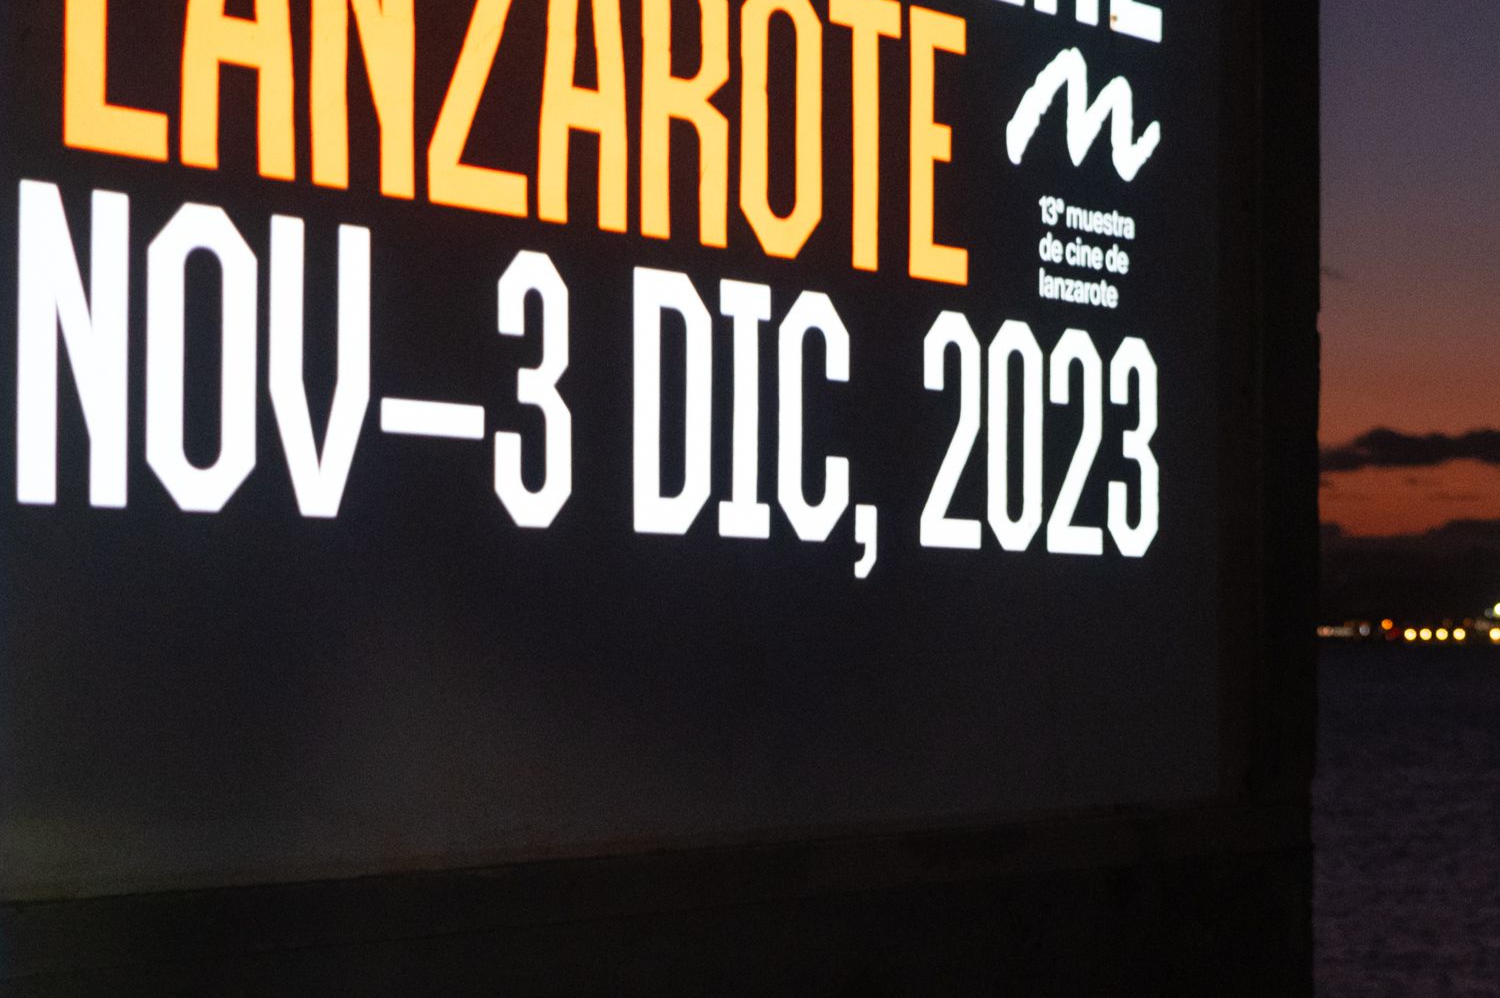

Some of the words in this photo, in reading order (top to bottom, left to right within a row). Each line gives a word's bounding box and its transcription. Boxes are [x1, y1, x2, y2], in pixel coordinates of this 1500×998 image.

[1066, 205, 1135, 240] muestra
[1038, 231, 1064, 264] de
[1065, 236, 1104, 271] cine
[1104, 243, 1130, 275] de
[1038, 267, 1119, 309] lanzarote
[632, 266, 878, 579] DIC,
[919, 310, 1160, 558] 2023
